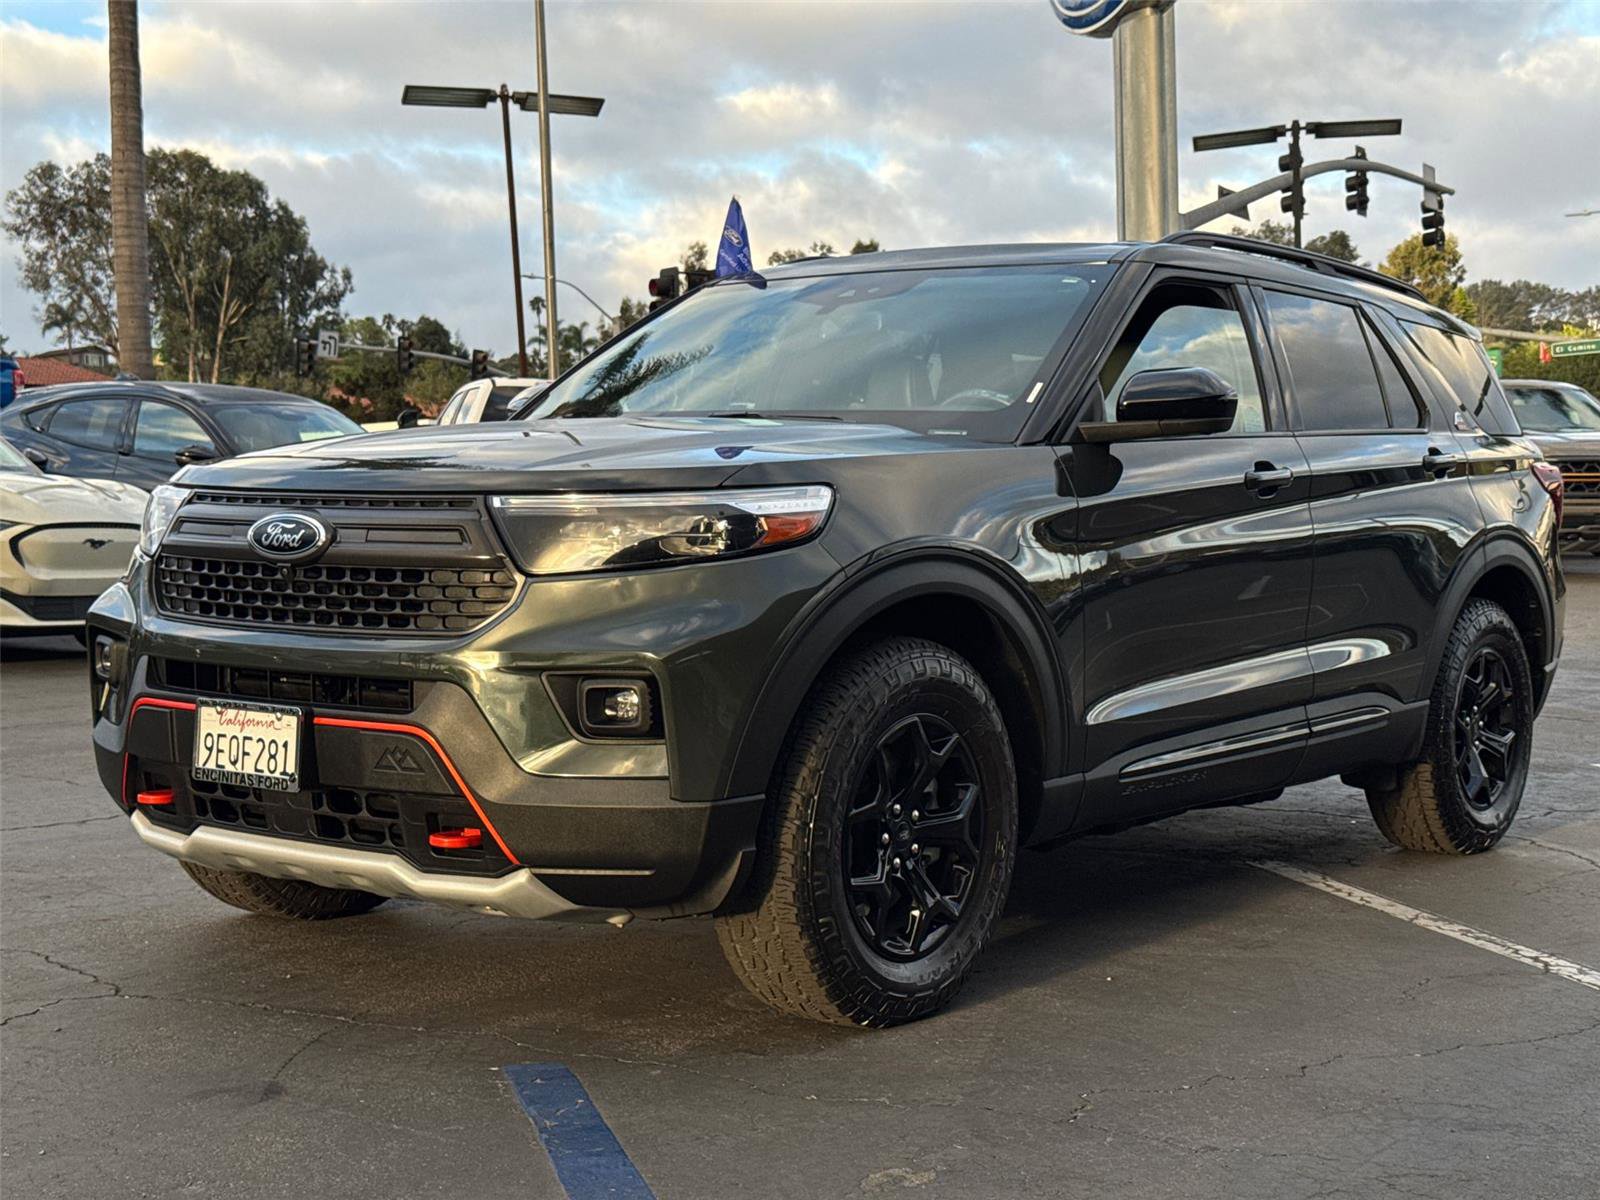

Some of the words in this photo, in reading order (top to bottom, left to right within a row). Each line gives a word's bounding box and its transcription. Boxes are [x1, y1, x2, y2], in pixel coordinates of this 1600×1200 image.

[1567, 344, 1596, 352] Camino
[261, 522, 305, 547] Ford
[218, 708, 281, 733] California
[202, 732, 290, 776] 9EQF281
[195, 768, 255, 787] ENCINITAS
[258, 774, 289, 791] FORD
